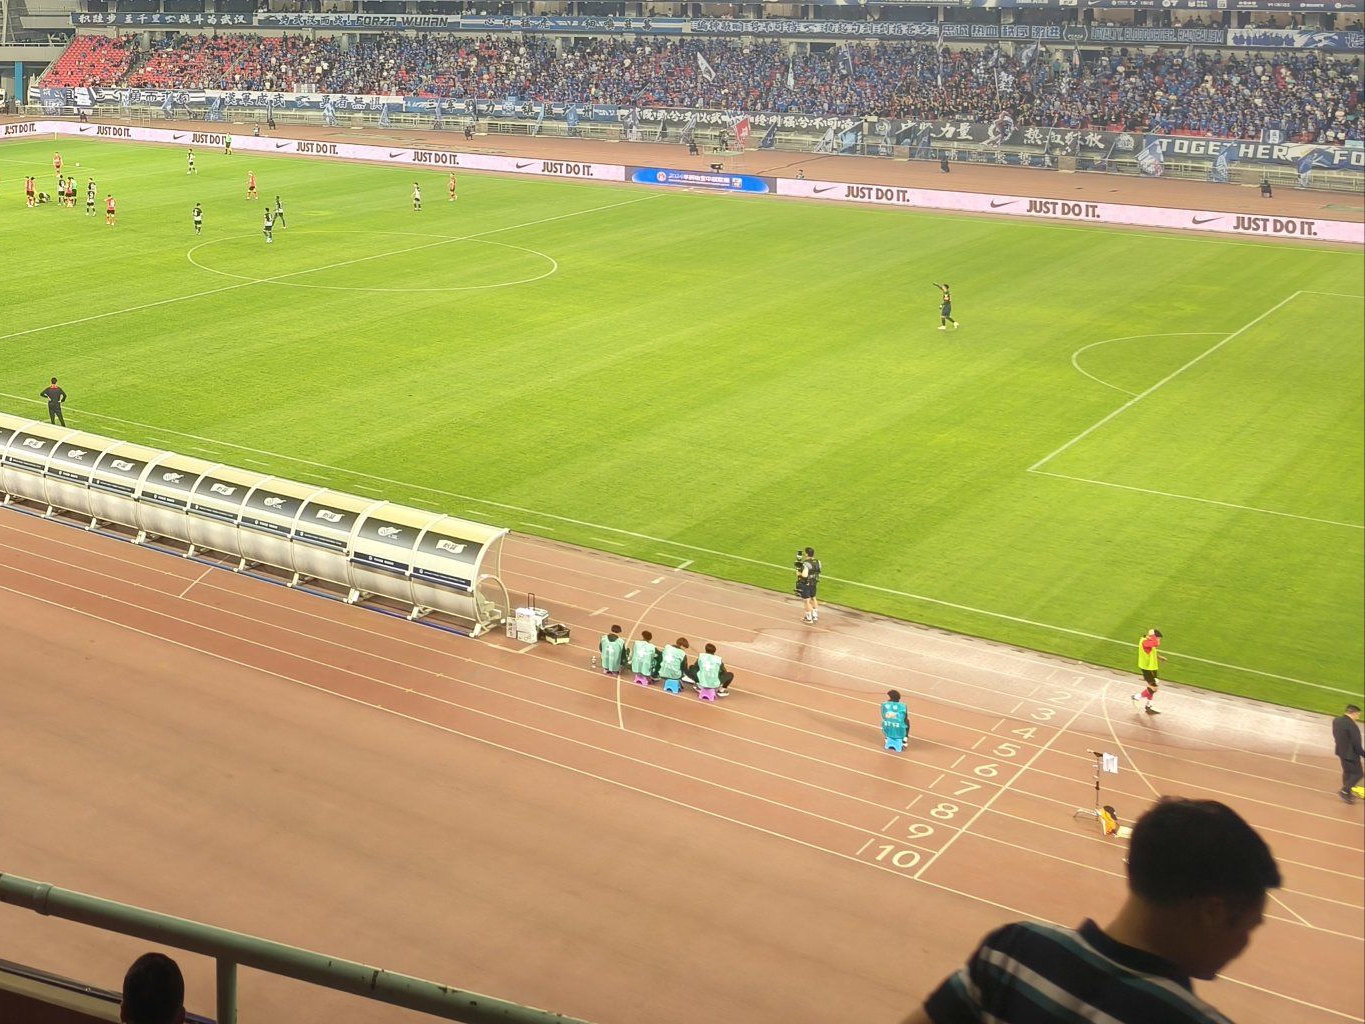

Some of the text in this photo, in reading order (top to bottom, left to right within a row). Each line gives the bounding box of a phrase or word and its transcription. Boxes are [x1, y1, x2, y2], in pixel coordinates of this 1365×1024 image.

[124, 13, 161, 24] 至千里
[178, 13, 247, 25] 战斗为武汉
[401, 16, 448, 27] WUHAN
[97, 127, 111, 136] JUST
[112, 128, 123, 136] DO
[191, 134, 208, 143] JUST
[209, 135, 221, 144] DO
[296, 142, 338, 155] JUST DO IT.
[413, 151, 459, 165] JUST DO IT.
[541, 162, 593, 176] JUST DO IT.
[845, 186, 910, 203] JUST DO IT.
[1027, 199, 1100, 218] JUST DO IT.
[1233, 216, 1318, 236] JUST DO IT.
[1048, 690, 1073, 703] 2
[1031, 707, 1056, 721] 3
[1011, 727, 1037, 740] 4
[992, 742, 1021, 757] 5
[973, 763, 998, 777] 6
[953, 780, 982, 796] 7
[930, 803, 959, 820] 8
[905, 824, 934, 839] 9
[875, 844, 921, 868] 10
